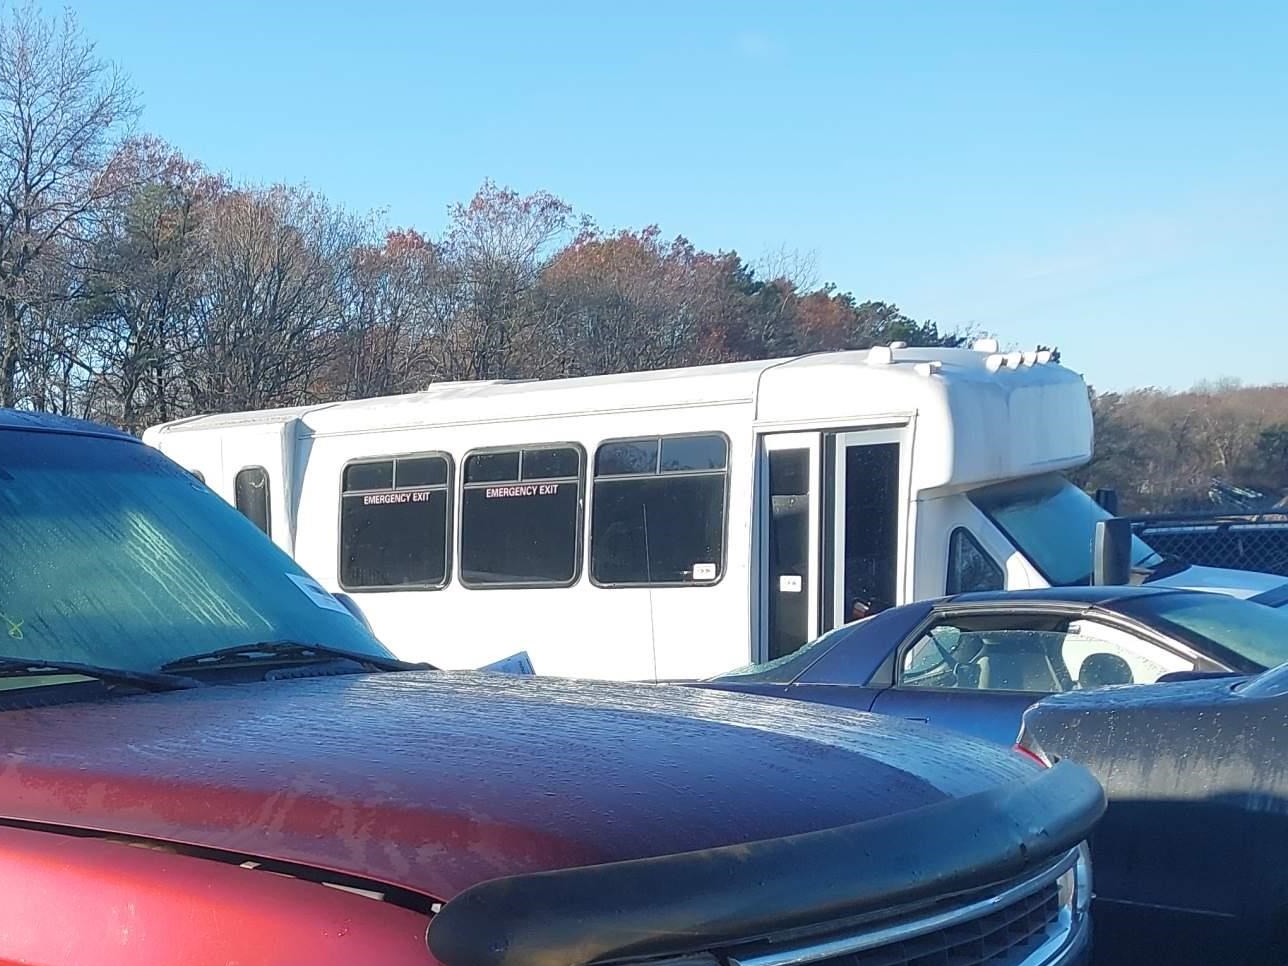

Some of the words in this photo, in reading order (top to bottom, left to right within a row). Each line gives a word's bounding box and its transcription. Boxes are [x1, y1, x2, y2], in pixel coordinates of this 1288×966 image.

[363, 492, 411, 505] EMERGENCY
[412, 491, 431, 502] EXIT
[486, 485, 538, 498] EMERGENCY
[539, 484, 559, 495] EXIT
